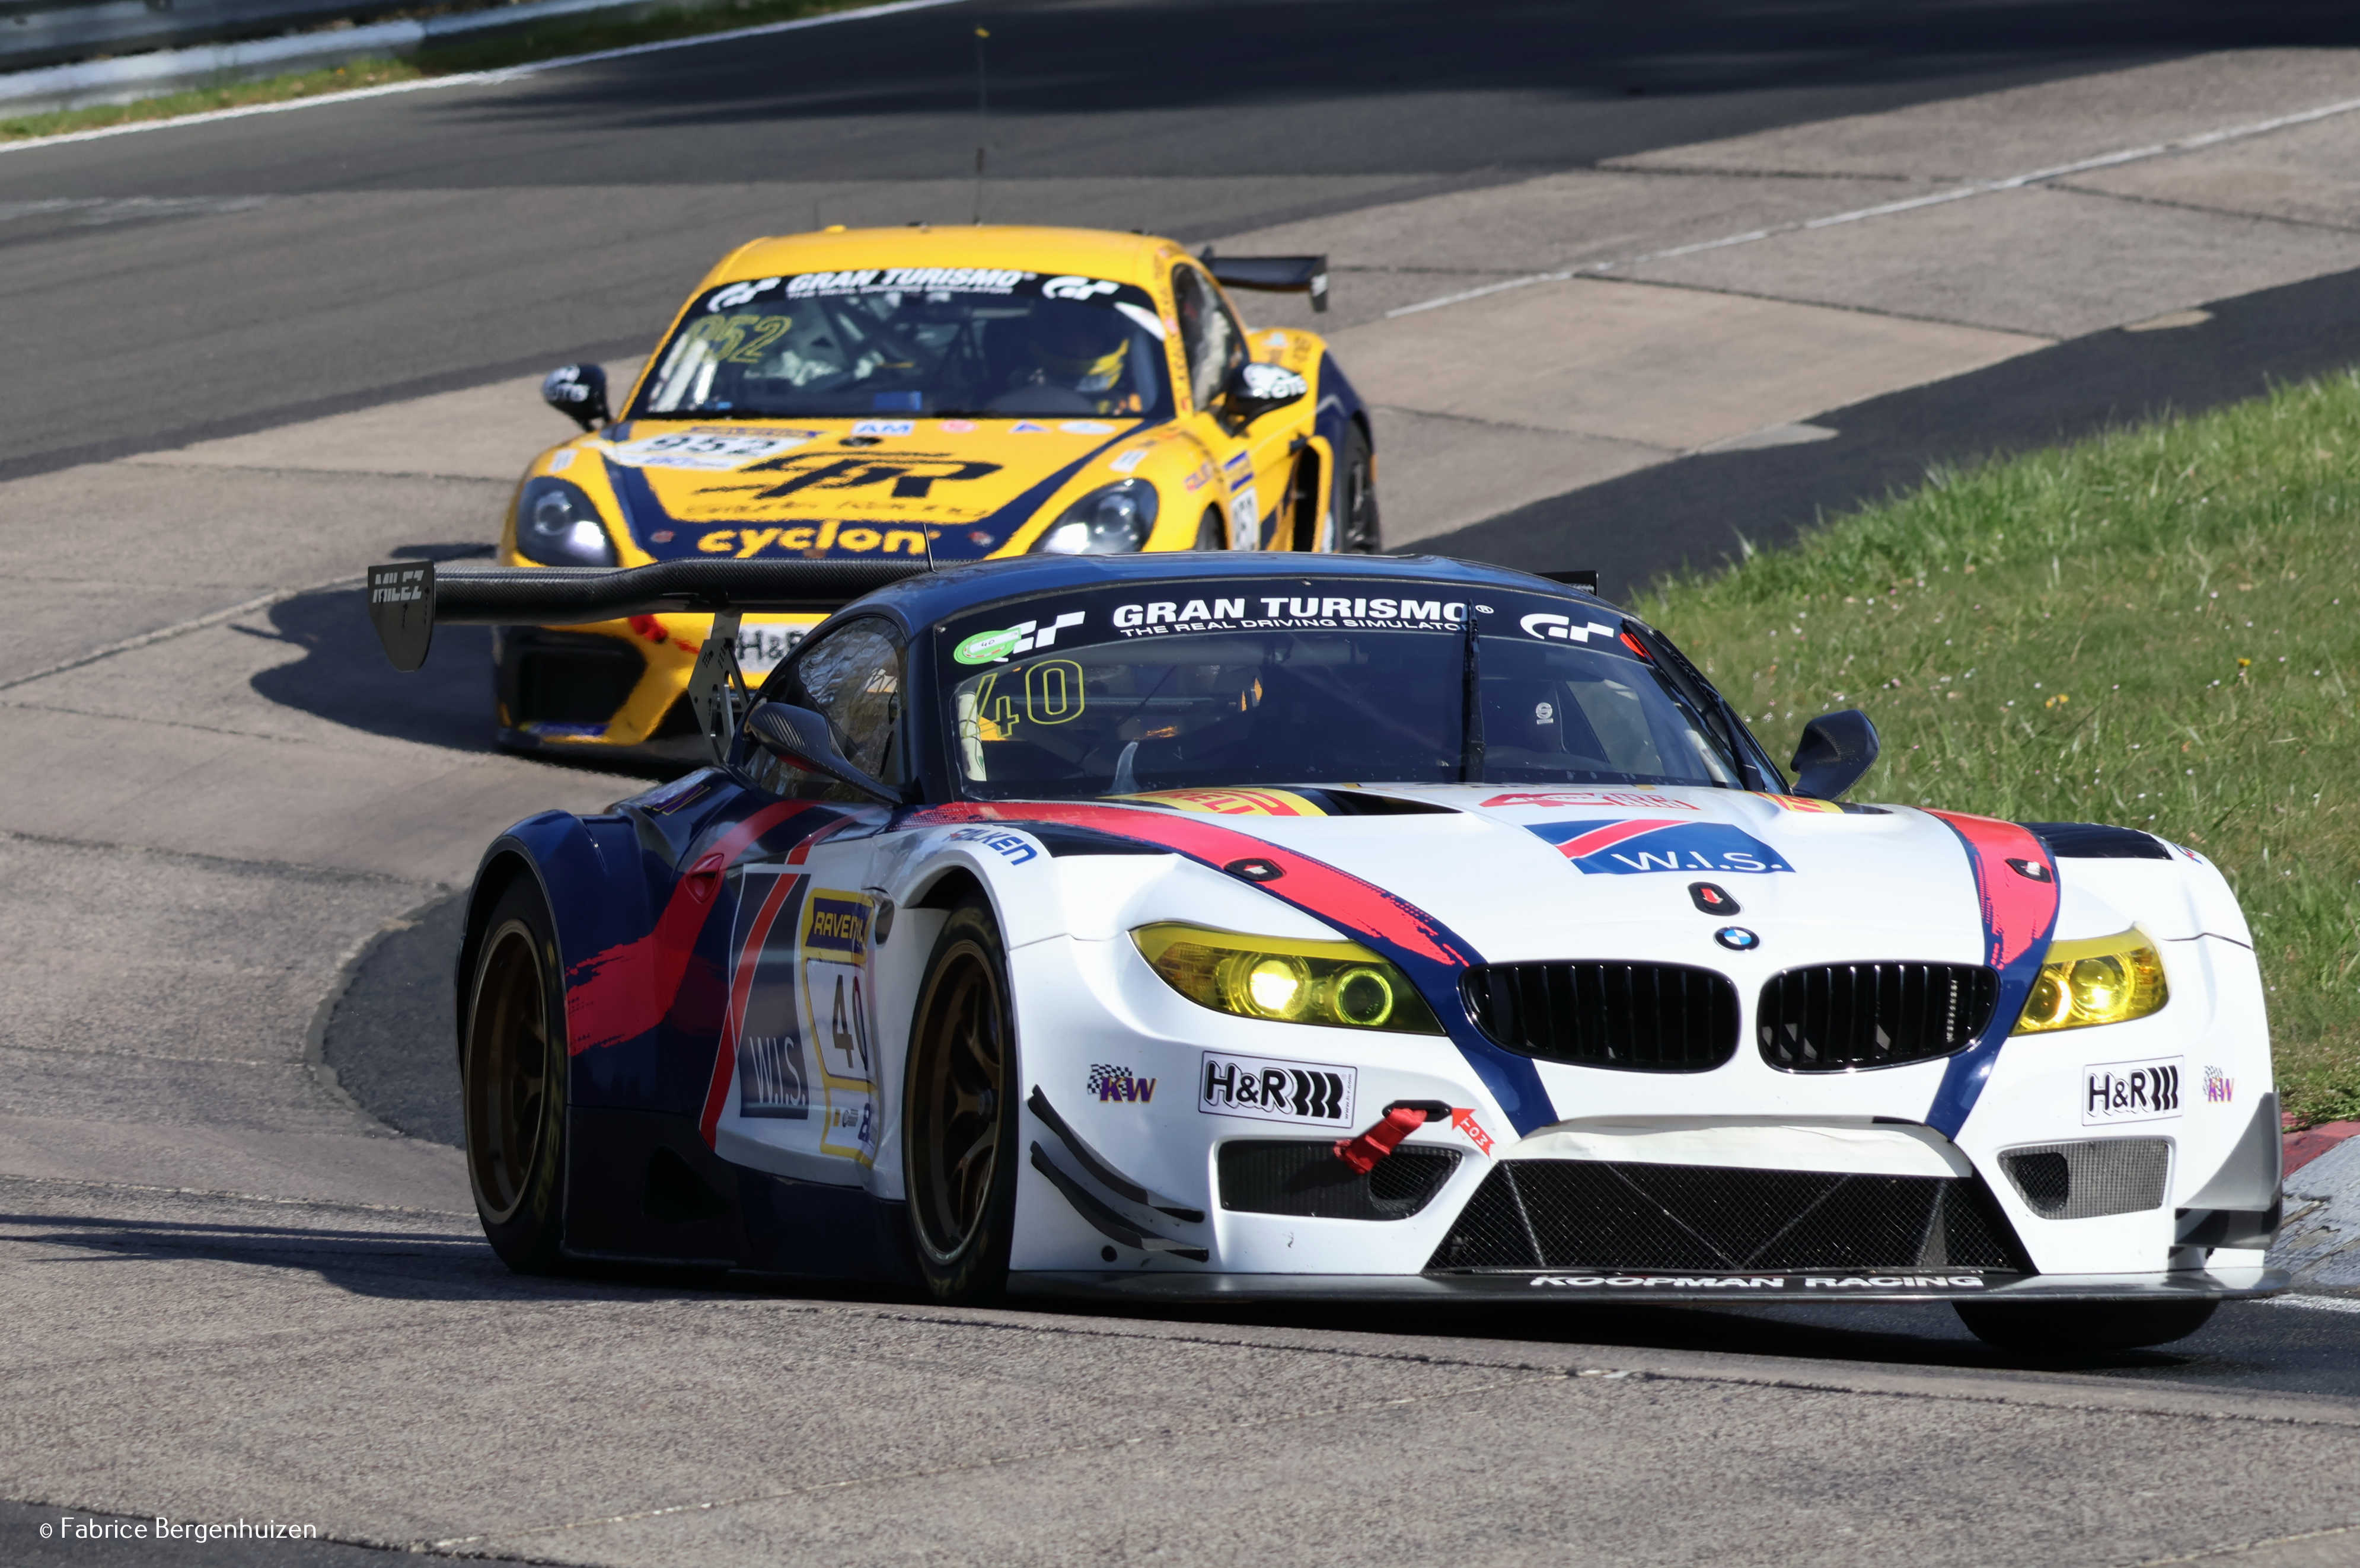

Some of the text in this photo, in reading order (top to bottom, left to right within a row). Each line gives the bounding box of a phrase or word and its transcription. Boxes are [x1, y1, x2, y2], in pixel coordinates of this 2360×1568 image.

[786, 268, 1024, 290] GRAN TURISMO
[858, 423, 910, 433] AM
[645, 435, 779, 457] 952
[1112, 598, 1468, 628] GRAN TURISMO
[1120, 625, 1169, 637] THE
[1175, 620, 1238, 633] REAL
[1240, 619, 1338, 629] DRIVING
[981, 639, 996, 647] 40
[962, 659, 1085, 739] 40
[1610, 851, 1783, 871] W.I.S.
[833, 974, 869, 1071] 40
[749, 1036, 806, 1106] W.I.S.
[1099, 1076, 1157, 1103] KW
[1205, 1059, 1294, 1114] H&R
[2086, 1069, 2150, 1116] H&R
[2207, 1077, 2235, 1103] KW
[1460, 1117, 1489, 1147] TOW
[1530, 1276, 1985, 1288] KOOPMAN RACING
